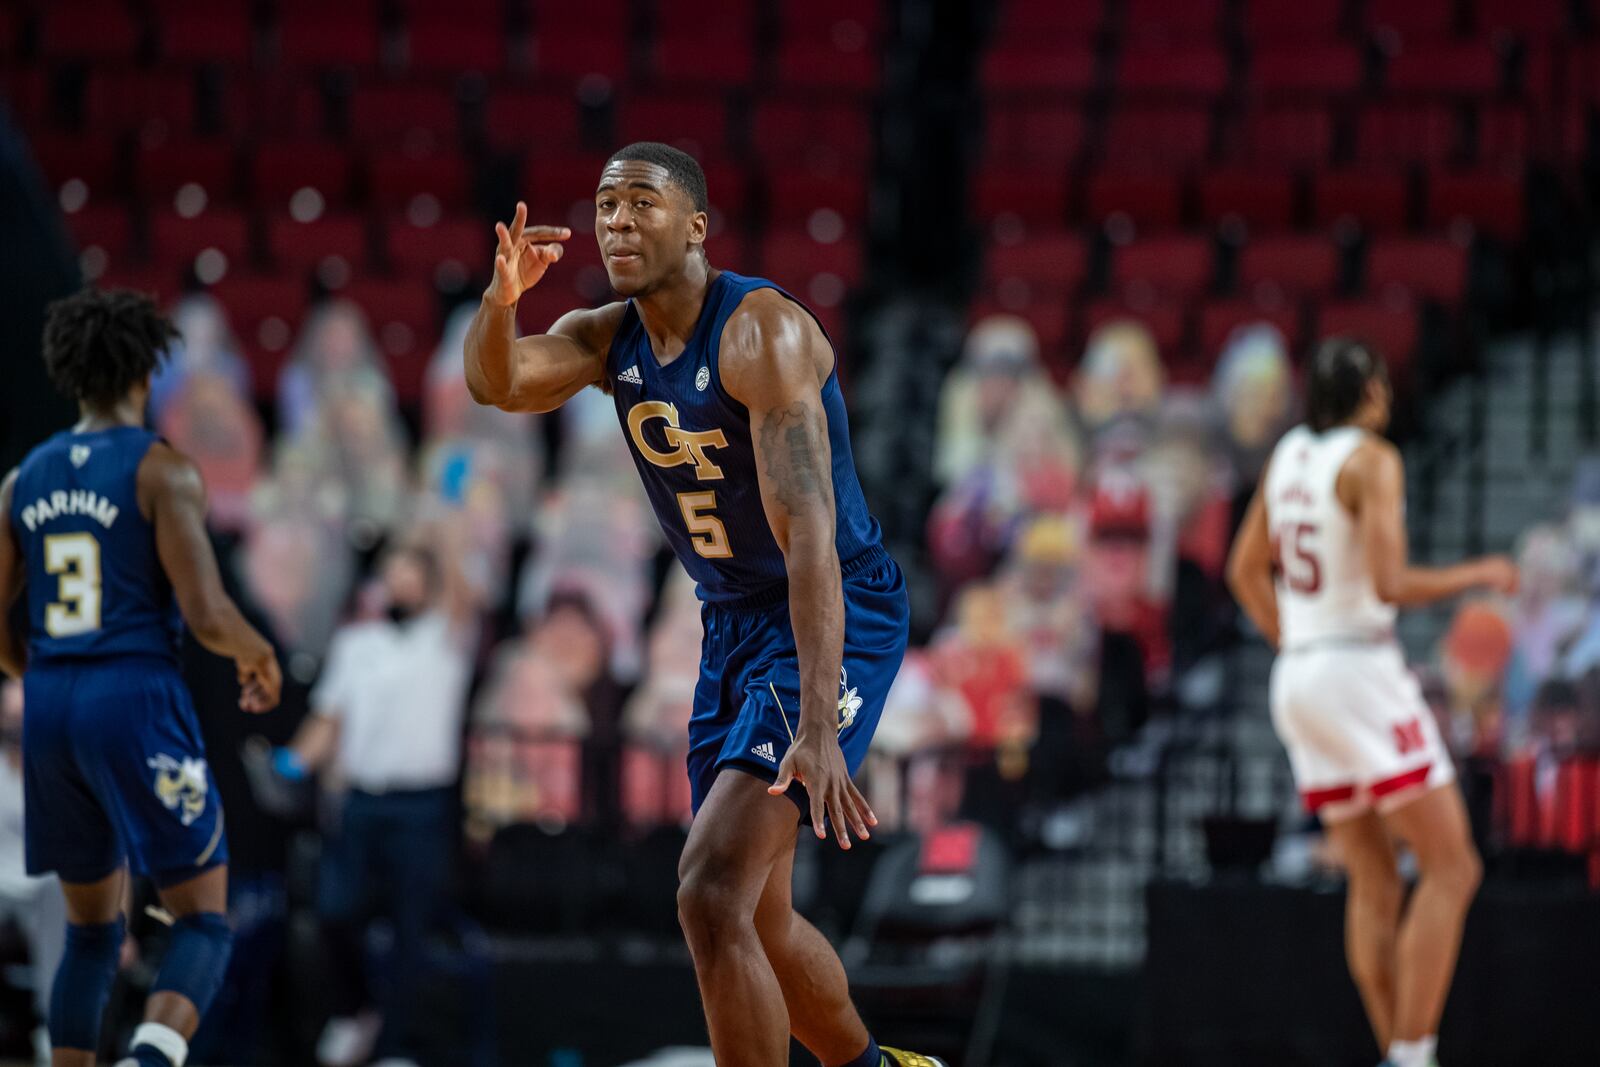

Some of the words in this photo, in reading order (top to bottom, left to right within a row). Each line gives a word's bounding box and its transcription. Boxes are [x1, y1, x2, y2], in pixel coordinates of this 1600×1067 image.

[617, 374, 643, 385] adidas
[627, 400, 729, 480] GT
[21, 489, 119, 532] PARHAM
[676, 490, 734, 558] 5
[43, 532, 102, 640] 3
[751, 747, 776, 763] adidas
